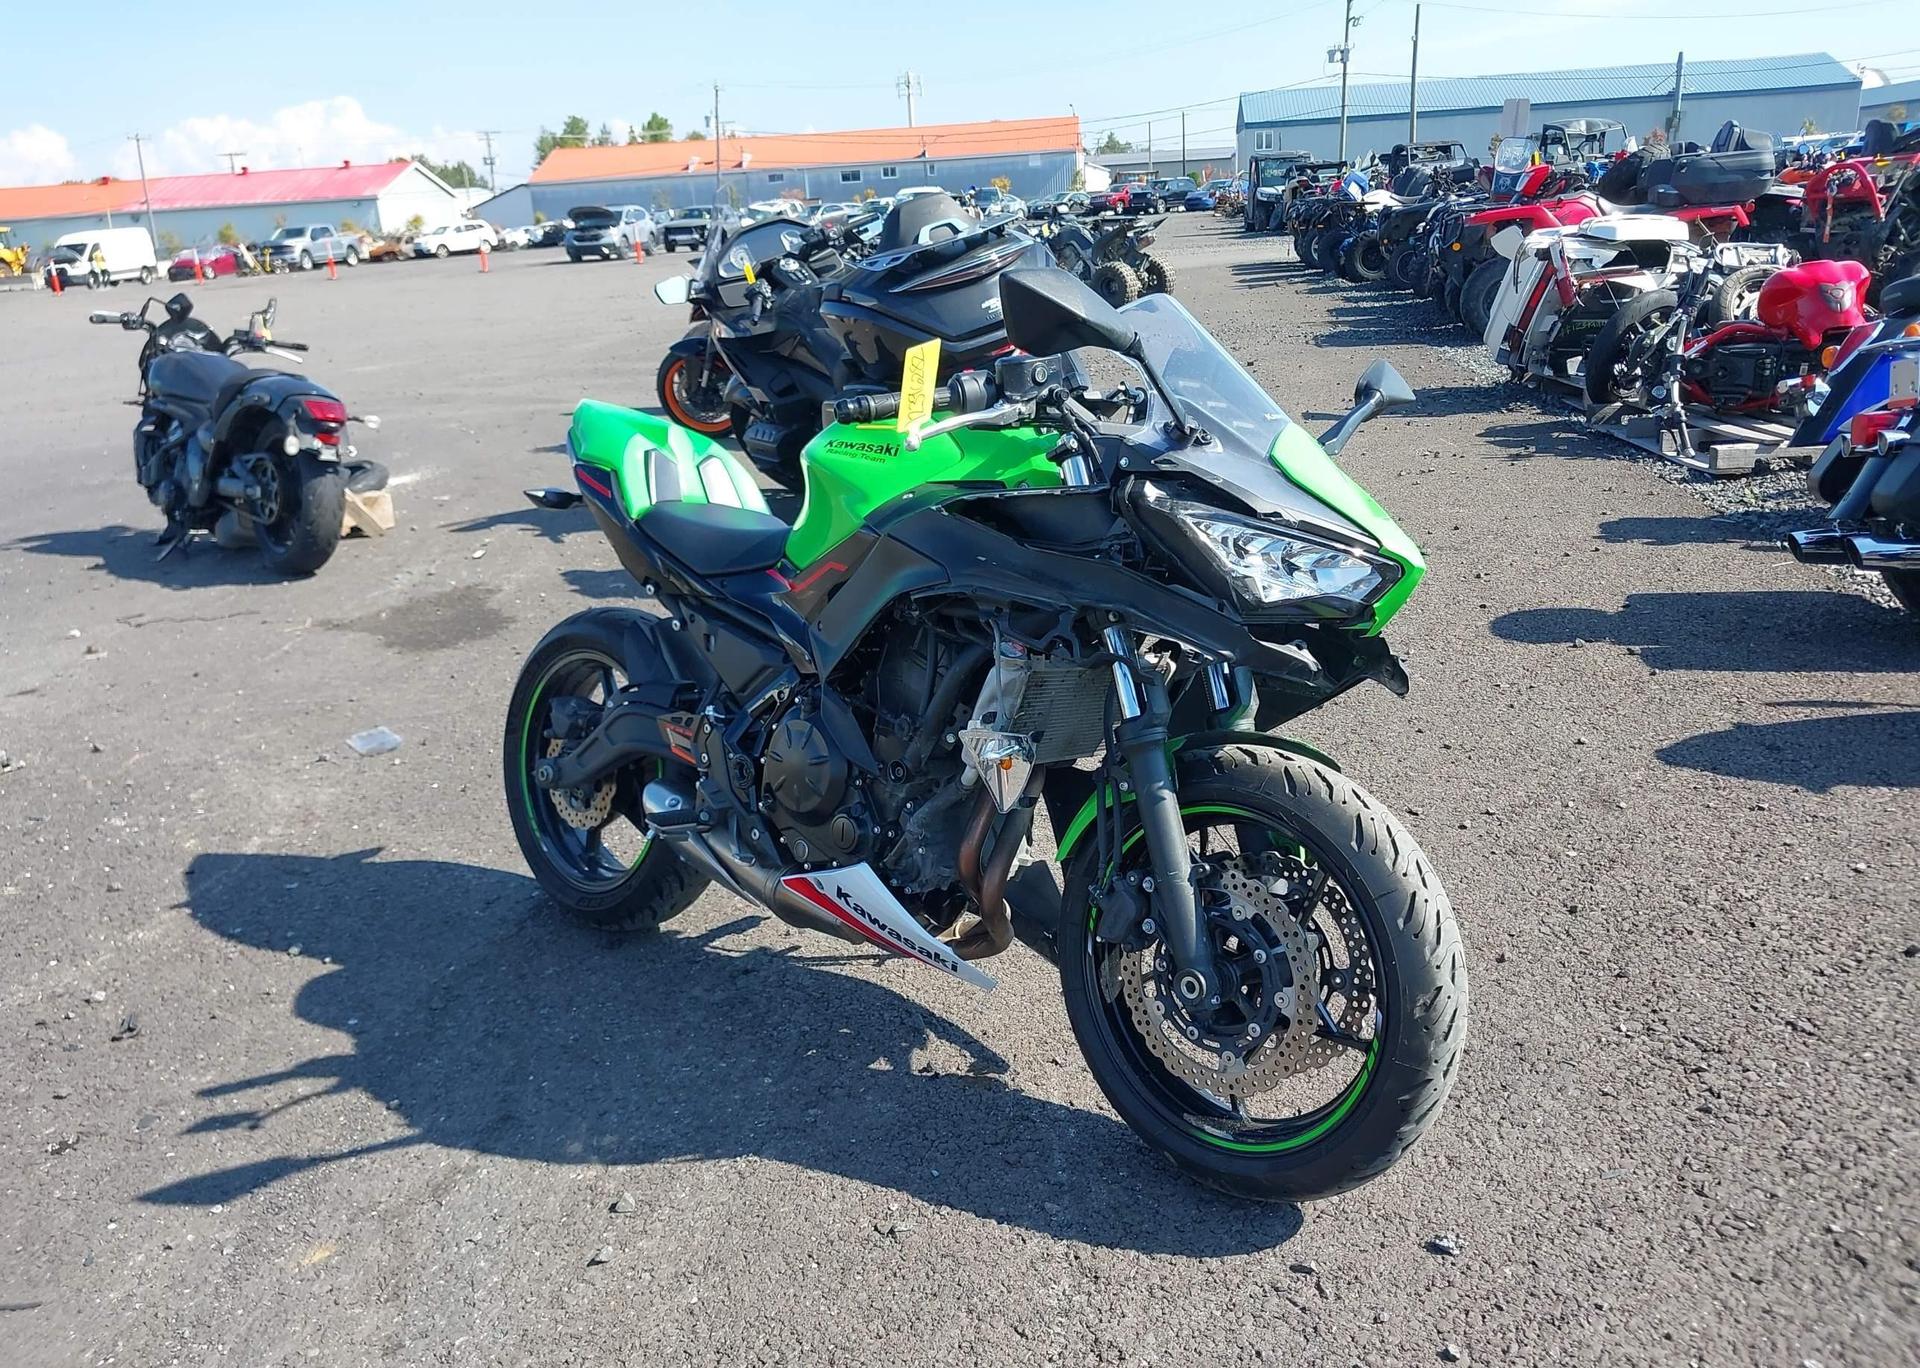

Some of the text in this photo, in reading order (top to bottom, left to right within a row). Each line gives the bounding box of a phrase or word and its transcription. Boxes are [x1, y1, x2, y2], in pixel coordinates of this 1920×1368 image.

[824, 439, 901, 457] Kawasaki
[826, 449, 886, 463] Racing Team
[837, 885, 958, 973] Kawasaki
